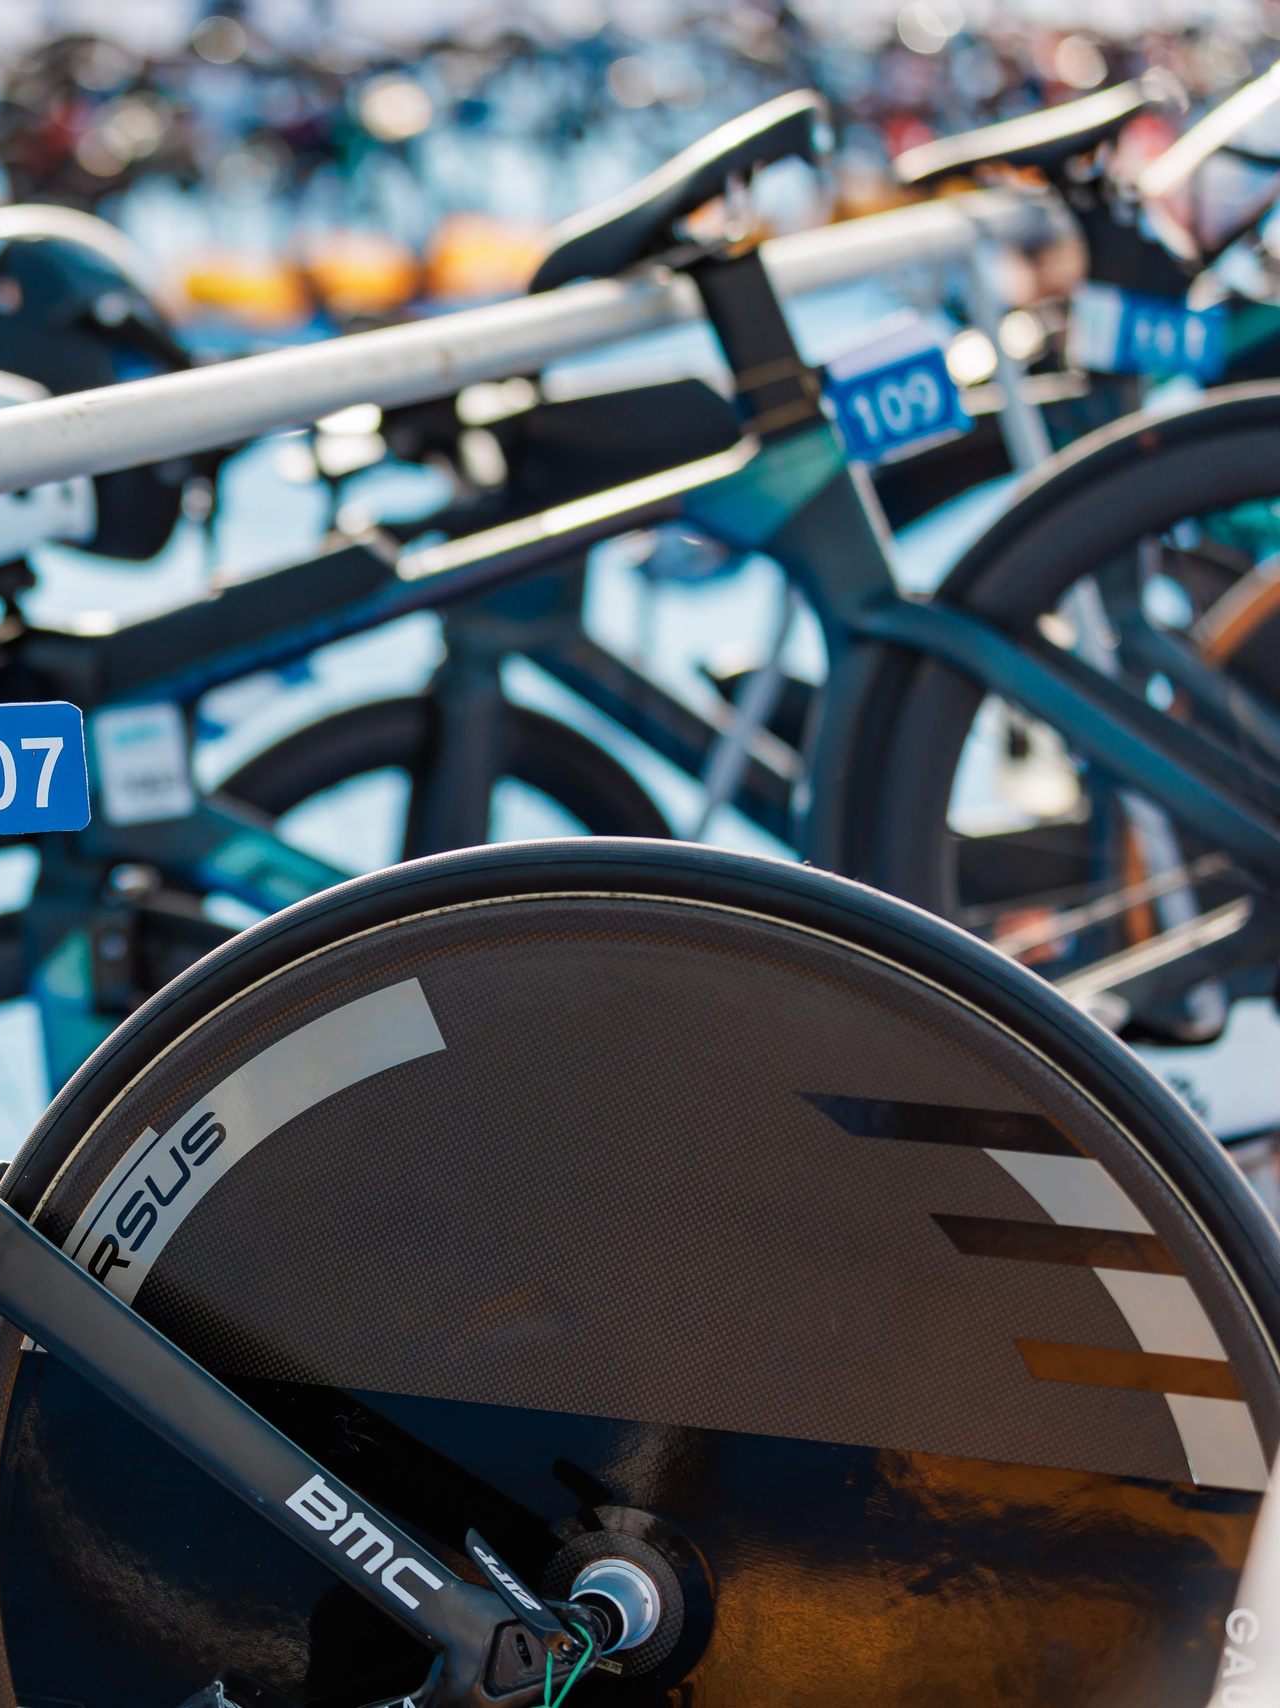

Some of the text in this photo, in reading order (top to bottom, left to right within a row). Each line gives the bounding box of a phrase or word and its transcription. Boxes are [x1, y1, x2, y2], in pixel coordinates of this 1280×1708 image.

[852, 365, 942, 443] 109
[285, 1474, 444, 1610] BMC
[473, 1546, 542, 1611] ZIPP
